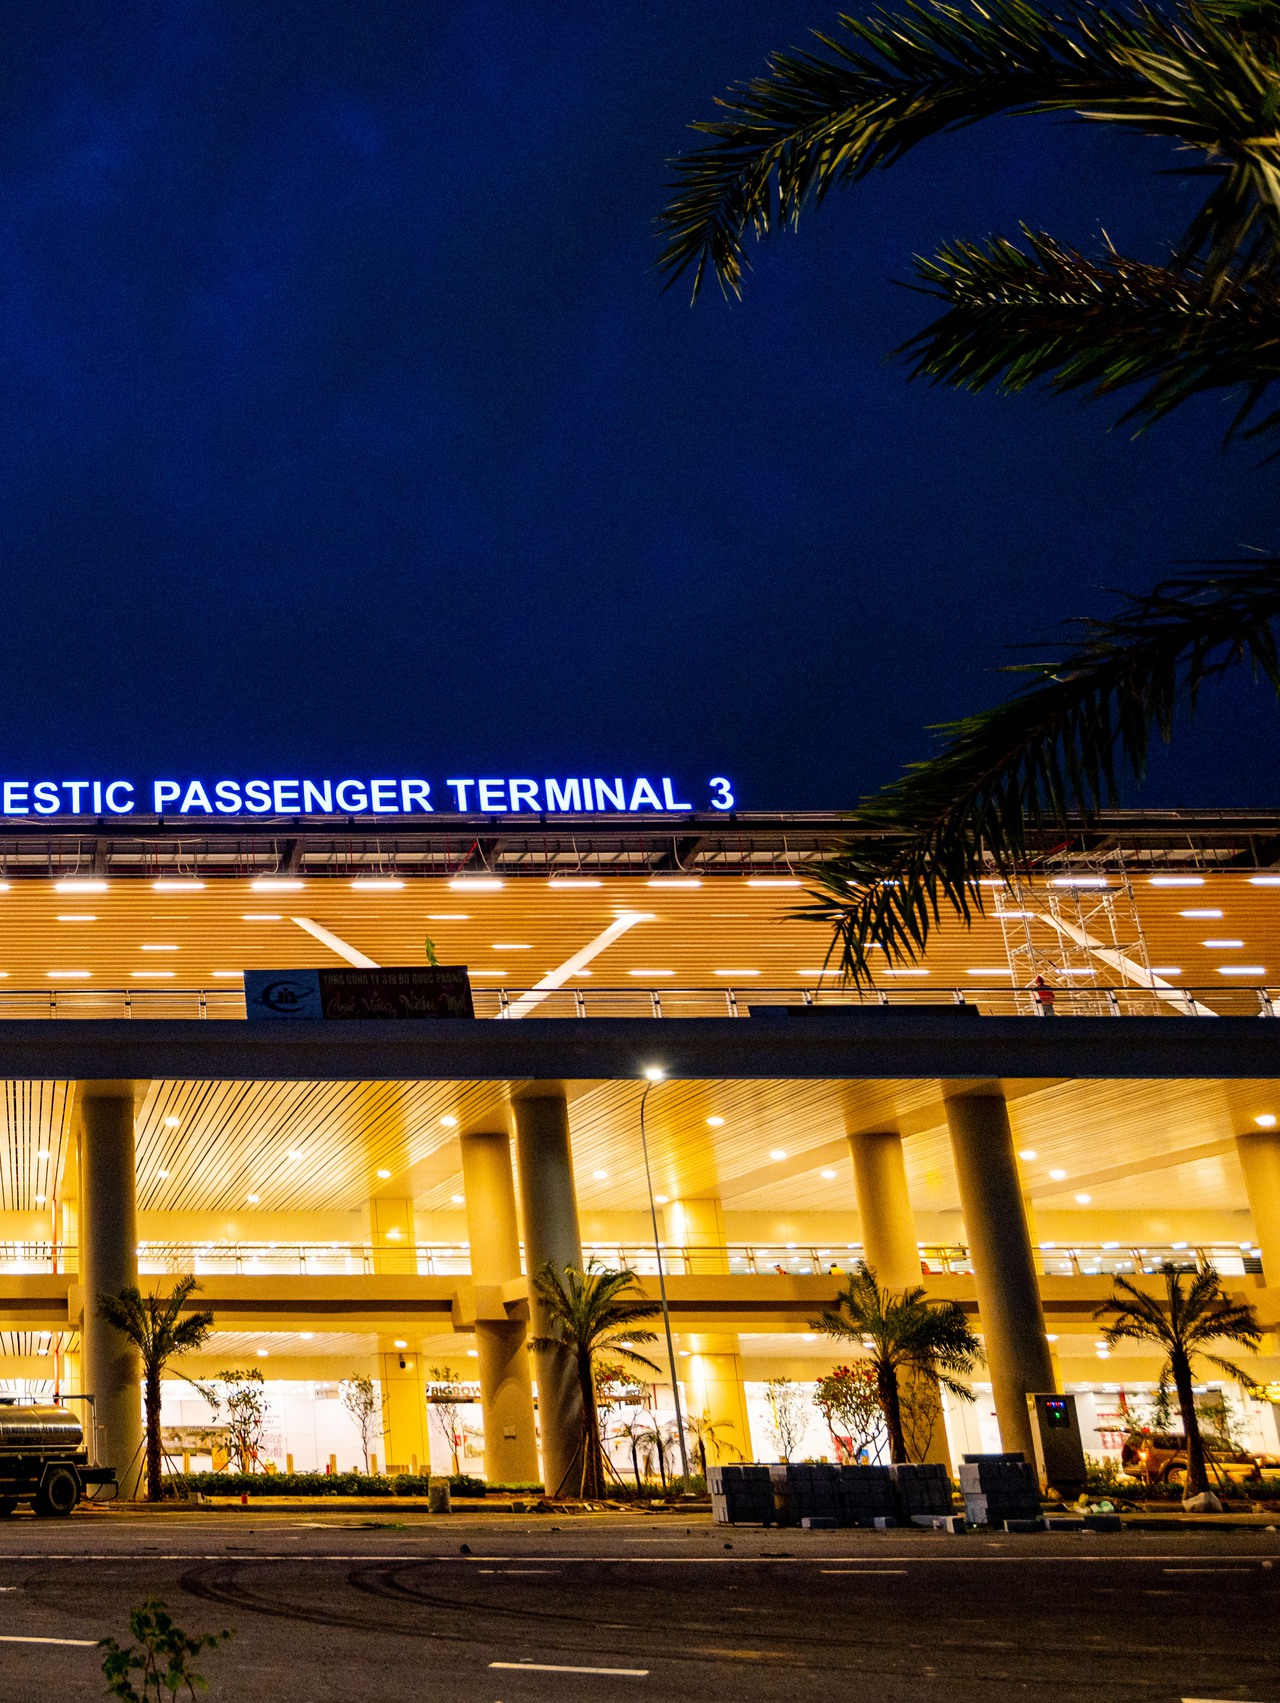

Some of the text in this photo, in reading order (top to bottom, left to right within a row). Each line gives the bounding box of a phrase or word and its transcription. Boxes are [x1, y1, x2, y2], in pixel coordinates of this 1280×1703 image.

[154, 779, 434, 813] PASSENGER
[446, 777, 692, 812] TERMINAL
[709, 777, 735, 810] 3
